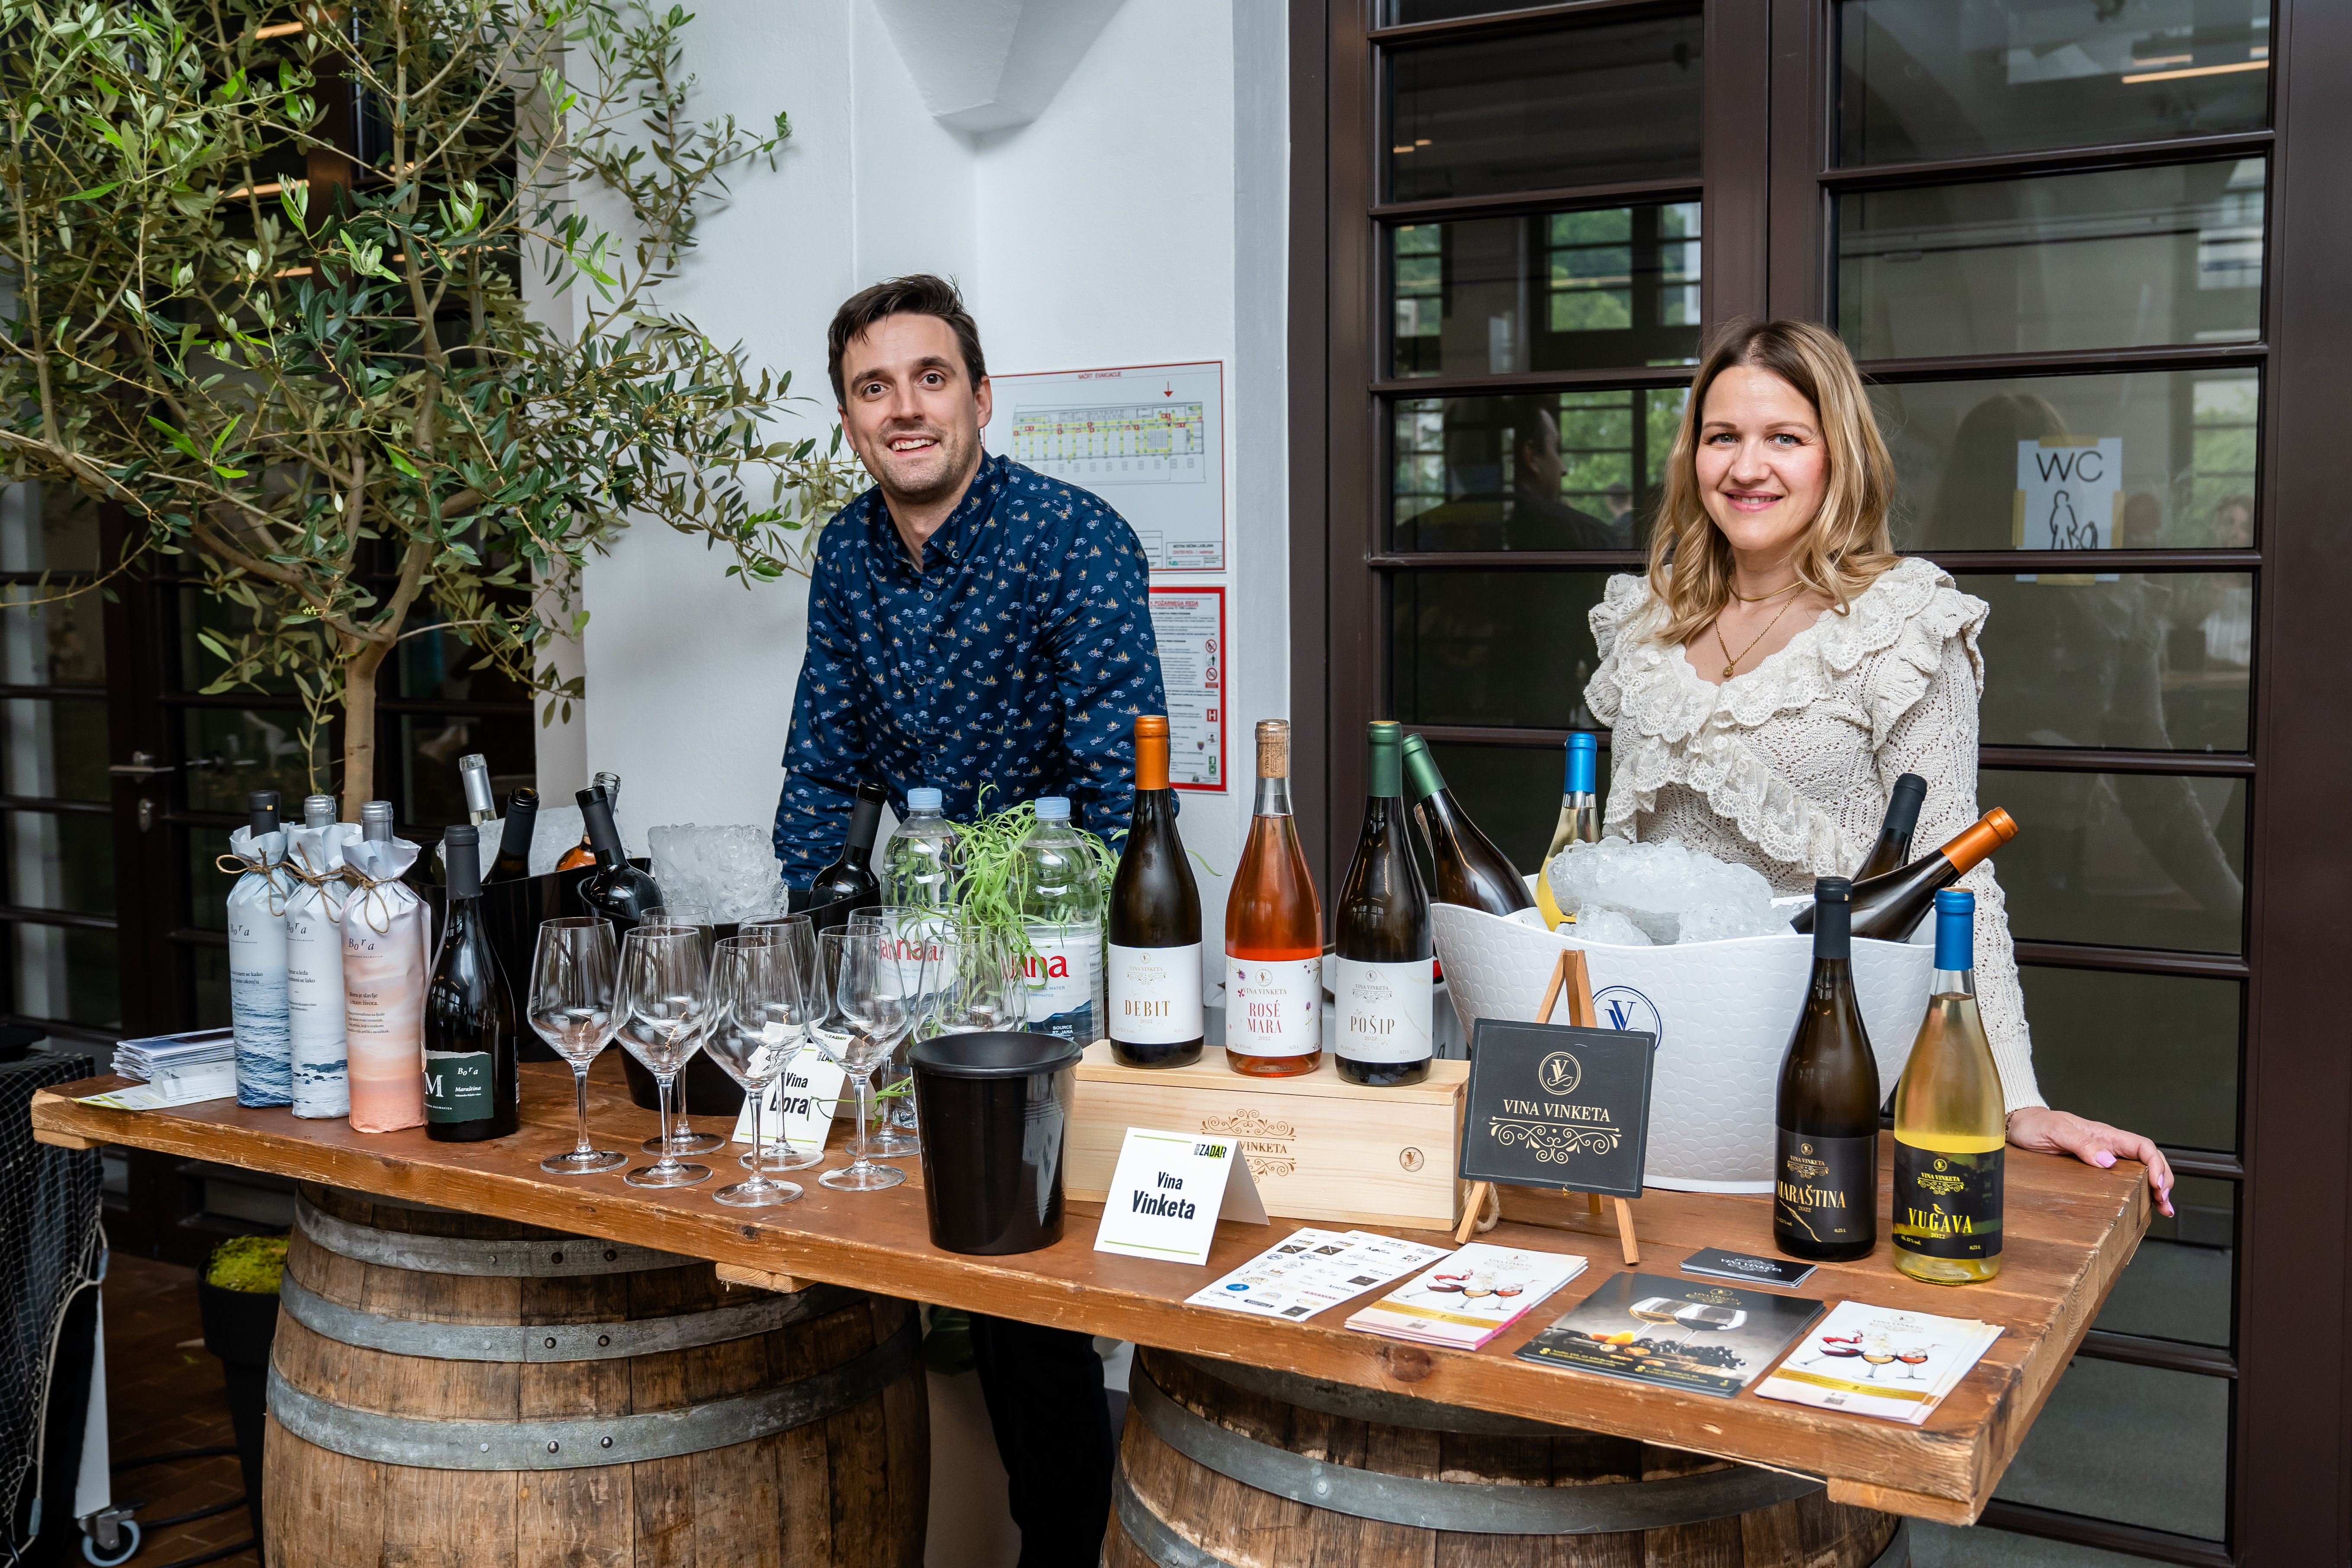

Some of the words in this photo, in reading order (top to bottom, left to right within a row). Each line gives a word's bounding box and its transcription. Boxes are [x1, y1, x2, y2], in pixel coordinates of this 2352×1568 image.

[2036, 451, 2103, 482] WC
[230, 923, 250, 936] Bora
[287, 921, 307, 934] Bora
[349, 938, 374, 950] Bora
[1124, 1000, 1170, 1017] DEBIT
[1249, 1000, 1280, 1018] ROSÉ
[1247, 1018, 1282, 1034] MARA
[1351, 1014, 1395, 1034] POŠIP
[458, 1067, 478, 1075] Bora
[786, 1072, 808, 1088] Vina
[1503, 1100, 1540, 1115] VINA
[1544, 1103, 1611, 1122] VINKETA
[1238, 1141, 1287, 1154] VINKETA
[1802, 1156, 1825, 1166] VINKETA
[1158, 1171, 1183, 1190] Vina
[1777, 1180, 1846, 1208] MARAŠTINA
[1133, 1190, 1195, 1220] Vinketa
[1908, 1207, 1973, 1233] VUGAVA
[1744, 1262, 1782, 1272] VINKETA
